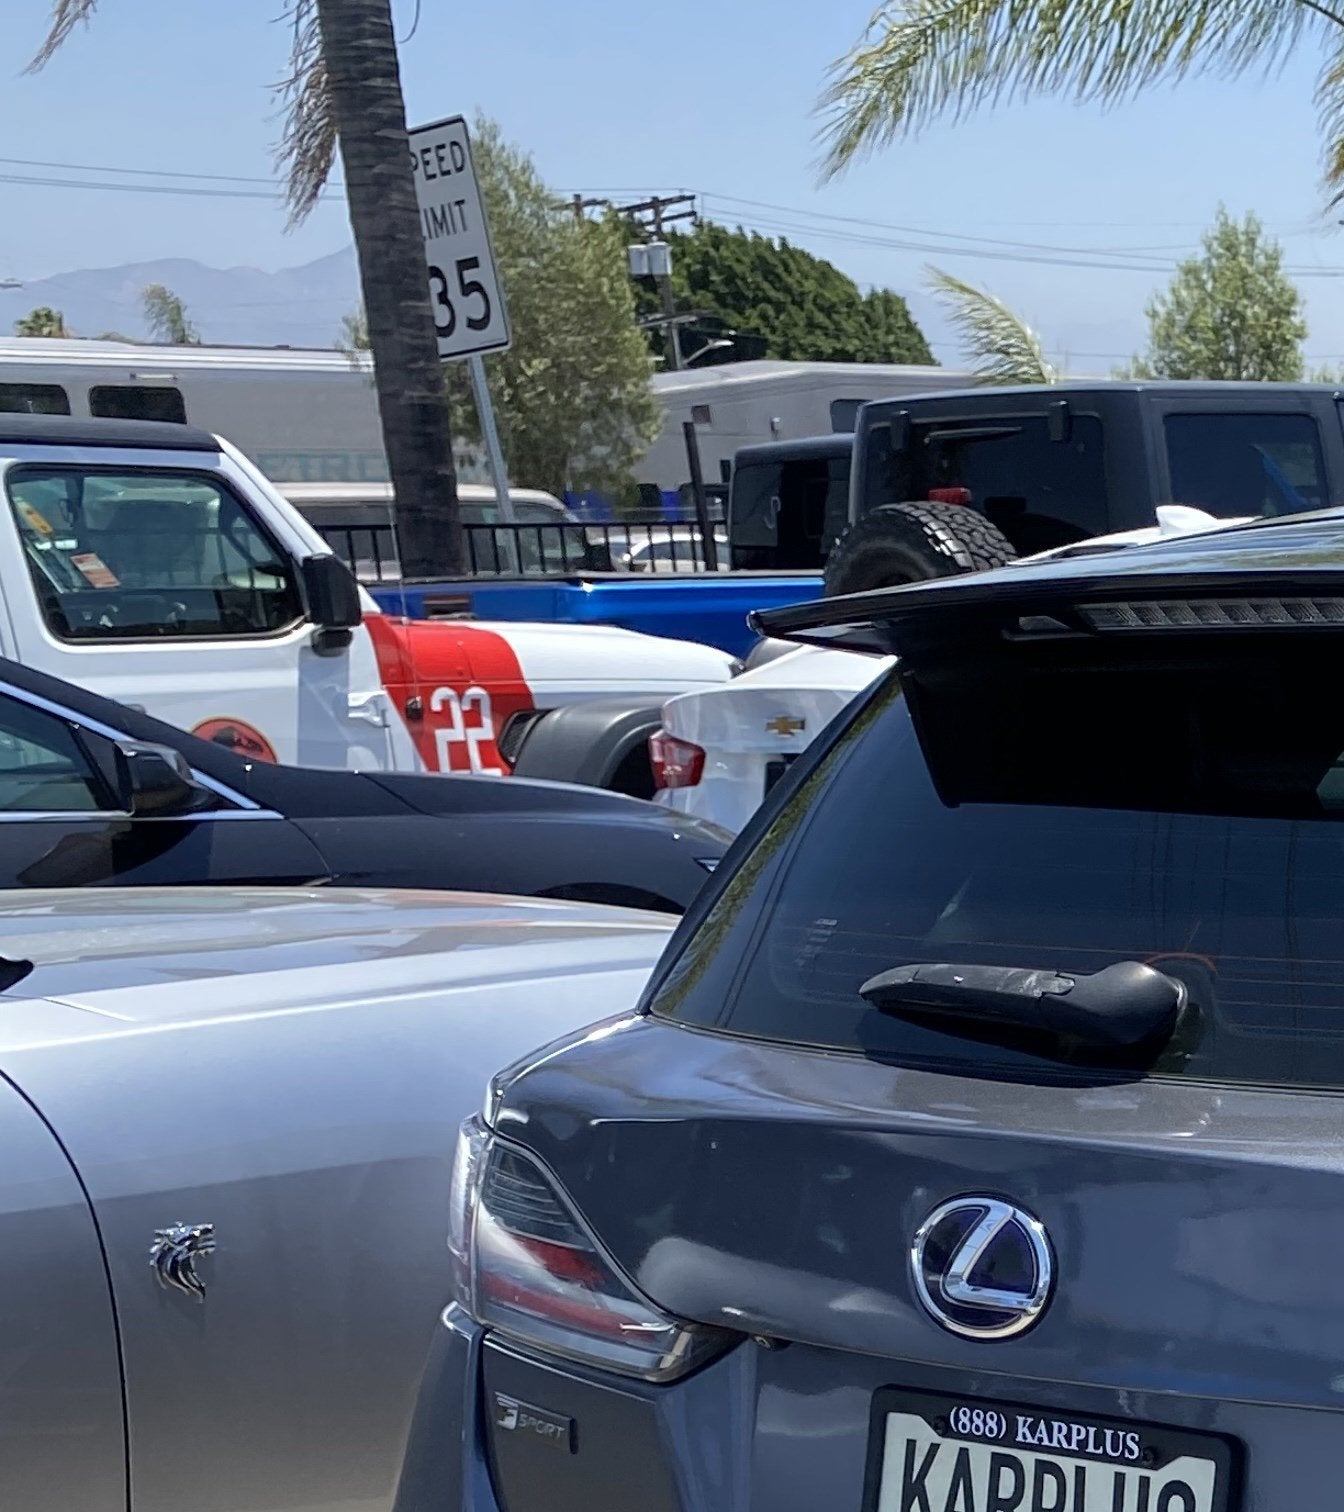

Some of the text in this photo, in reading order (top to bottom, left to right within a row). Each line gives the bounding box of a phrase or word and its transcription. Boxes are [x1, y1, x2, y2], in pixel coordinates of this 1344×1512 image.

[423, 199, 468, 242] IMIT
[428, 256, 491, 338] 35
[431, 686, 502, 775] 22
[518, 1413, 566, 1440] SPORT
[949, 1406, 1141, 1460] (888) KARPLUS
